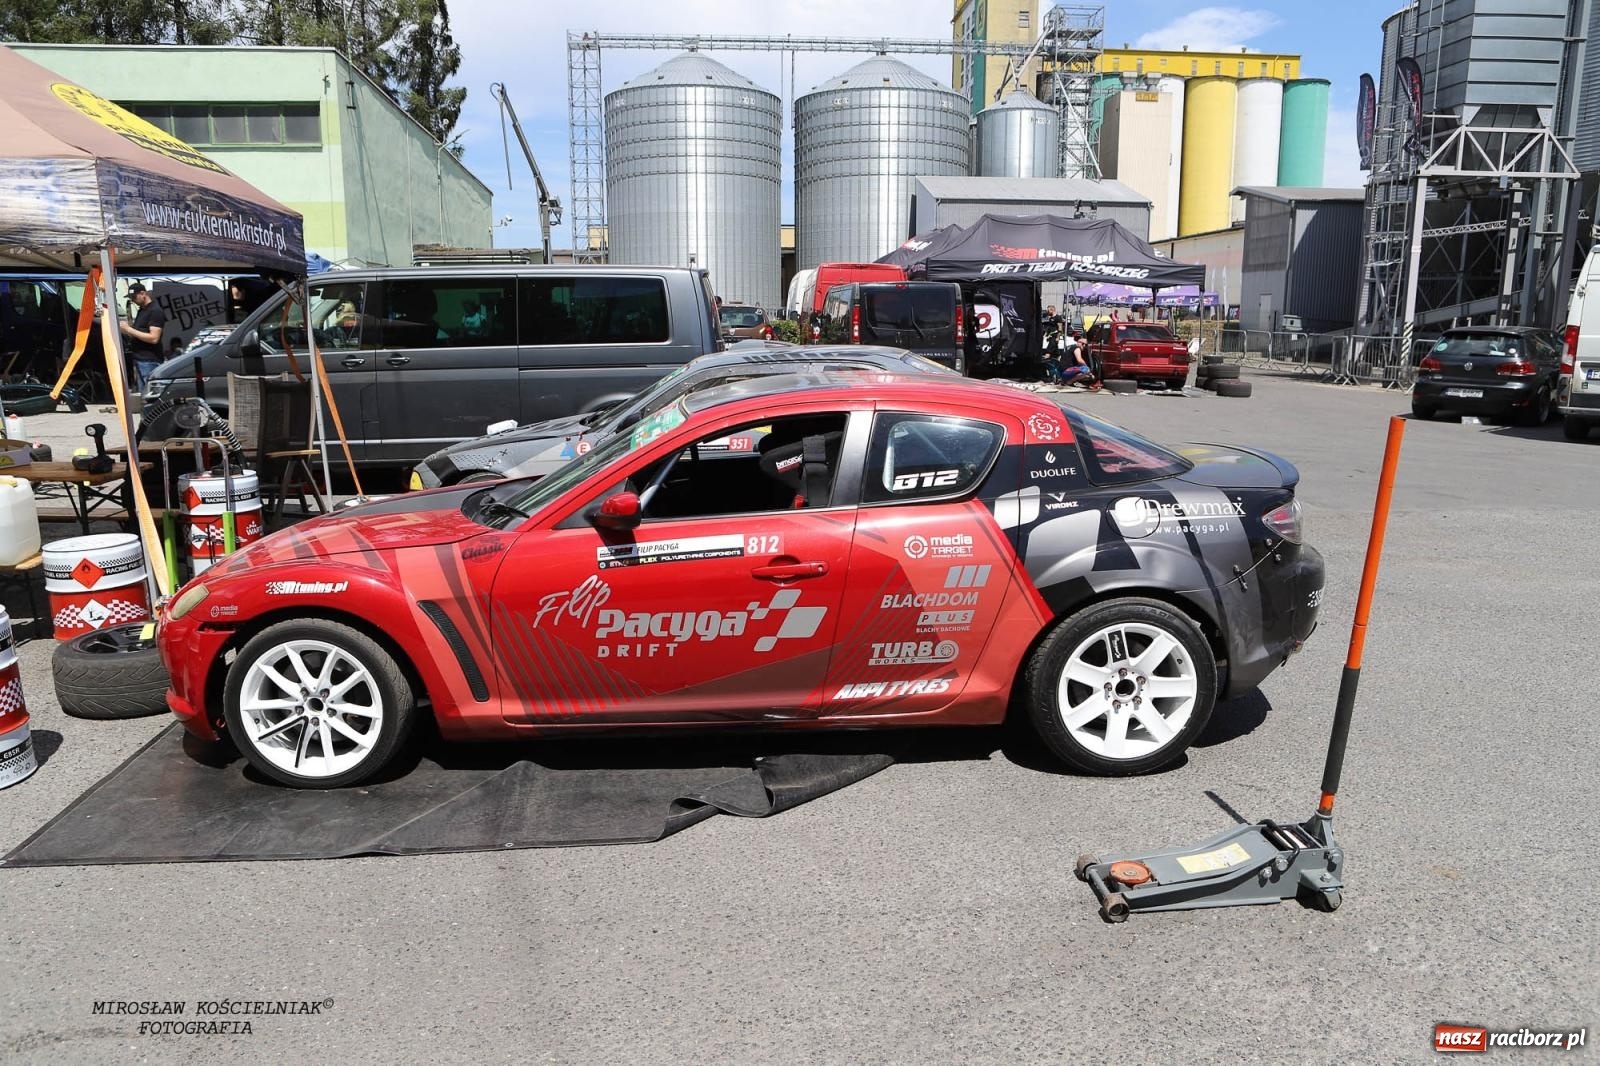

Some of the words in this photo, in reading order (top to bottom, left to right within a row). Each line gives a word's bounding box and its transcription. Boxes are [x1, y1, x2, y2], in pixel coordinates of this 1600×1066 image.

[142, 201, 287, 256] www.cukierniakristof.pl
[981, 263, 1021, 274] DRIFT
[1027, 261, 1066, 273] TEAM
[579, 442, 588, 456] E
[730, 438, 748, 450] 351
[1030, 467, 1077, 479] DUOLIFE
[1145, 497, 1246, 517] Drewmax
[1145, 521, 1230, 534] www.pacyga.pl
[747, 535, 779, 555] 812
[930, 534, 973, 545] media
[637, 545, 653, 553] FILIP
[654, 543, 679, 552] PACYGA
[931, 545, 973, 554] TARGET
[106, 563, 128, 574] RACING
[533, 575, 611, 628] Filip
[880, 592, 979, 609] BLACHDOM
[921, 612, 969, 624] PLUS
[595, 608, 749, 643] Pacyga
[597, 643, 678, 658] DRIFT
[874, 657, 917, 665] WORKS
[887, 678, 953, 697] TYRES
